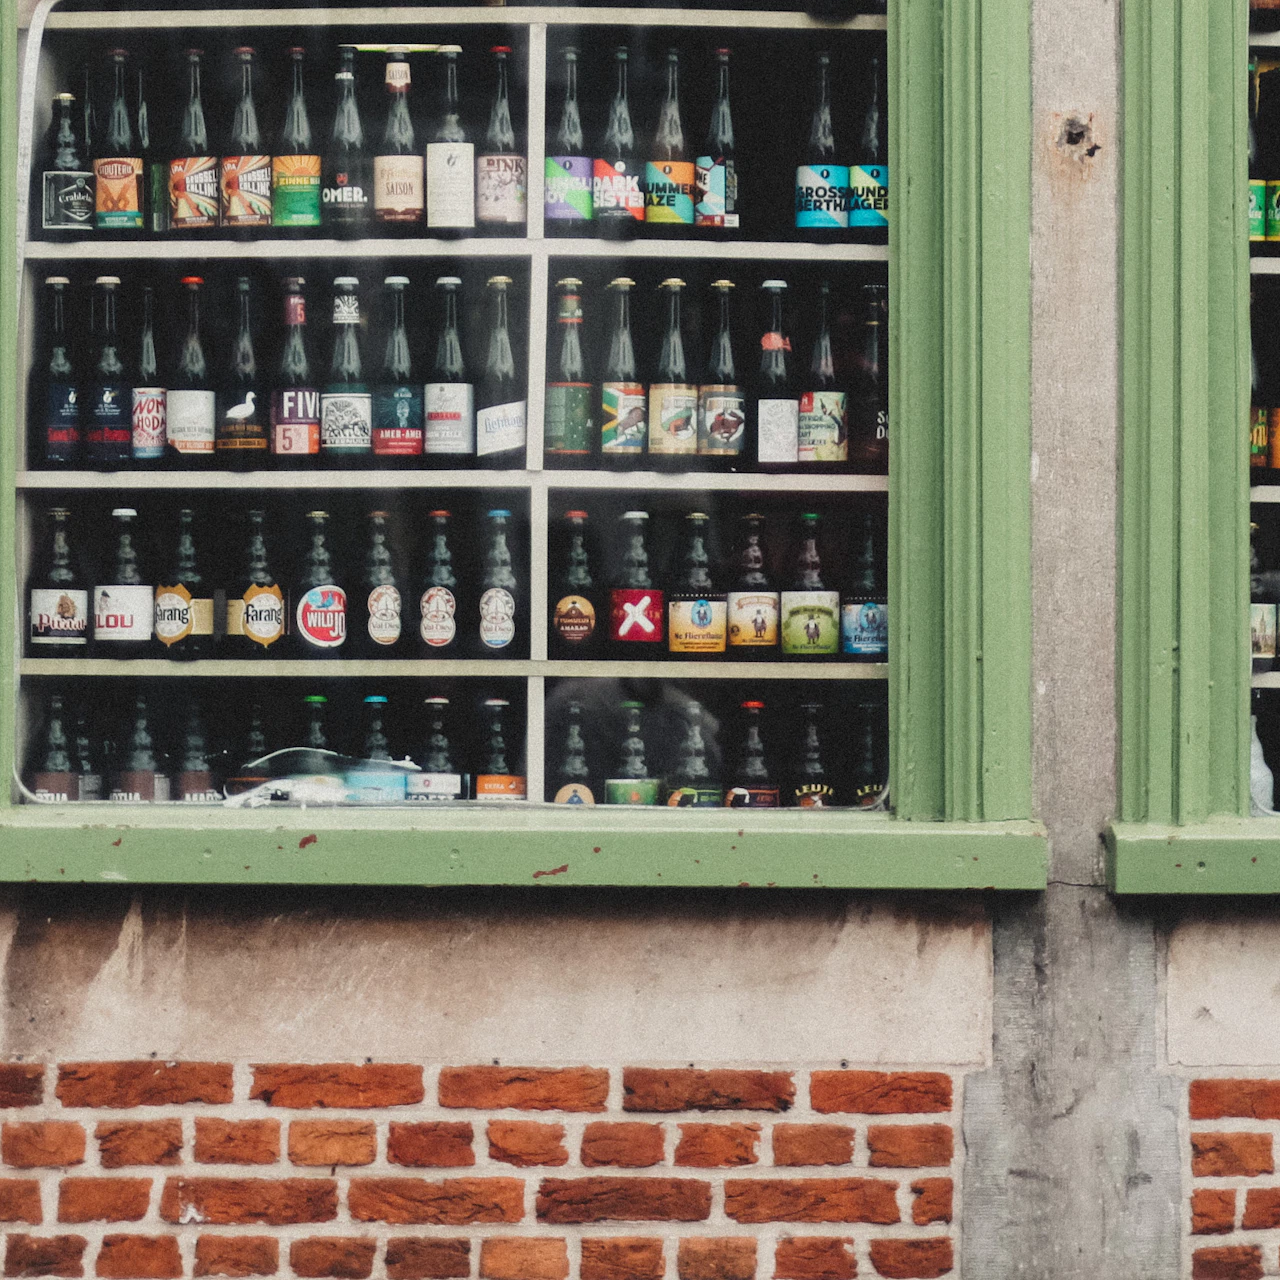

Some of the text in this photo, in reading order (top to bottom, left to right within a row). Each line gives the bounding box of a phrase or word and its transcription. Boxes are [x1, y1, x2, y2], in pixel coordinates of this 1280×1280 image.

[385, 181, 414, 196] SAISON
[593, 176, 640, 192] DARK
[322, 186, 368, 204] OMER.
[647, 194, 676, 207] AZE
[243, 604, 282, 625] farang
[307, 612, 332, 628] WILD
